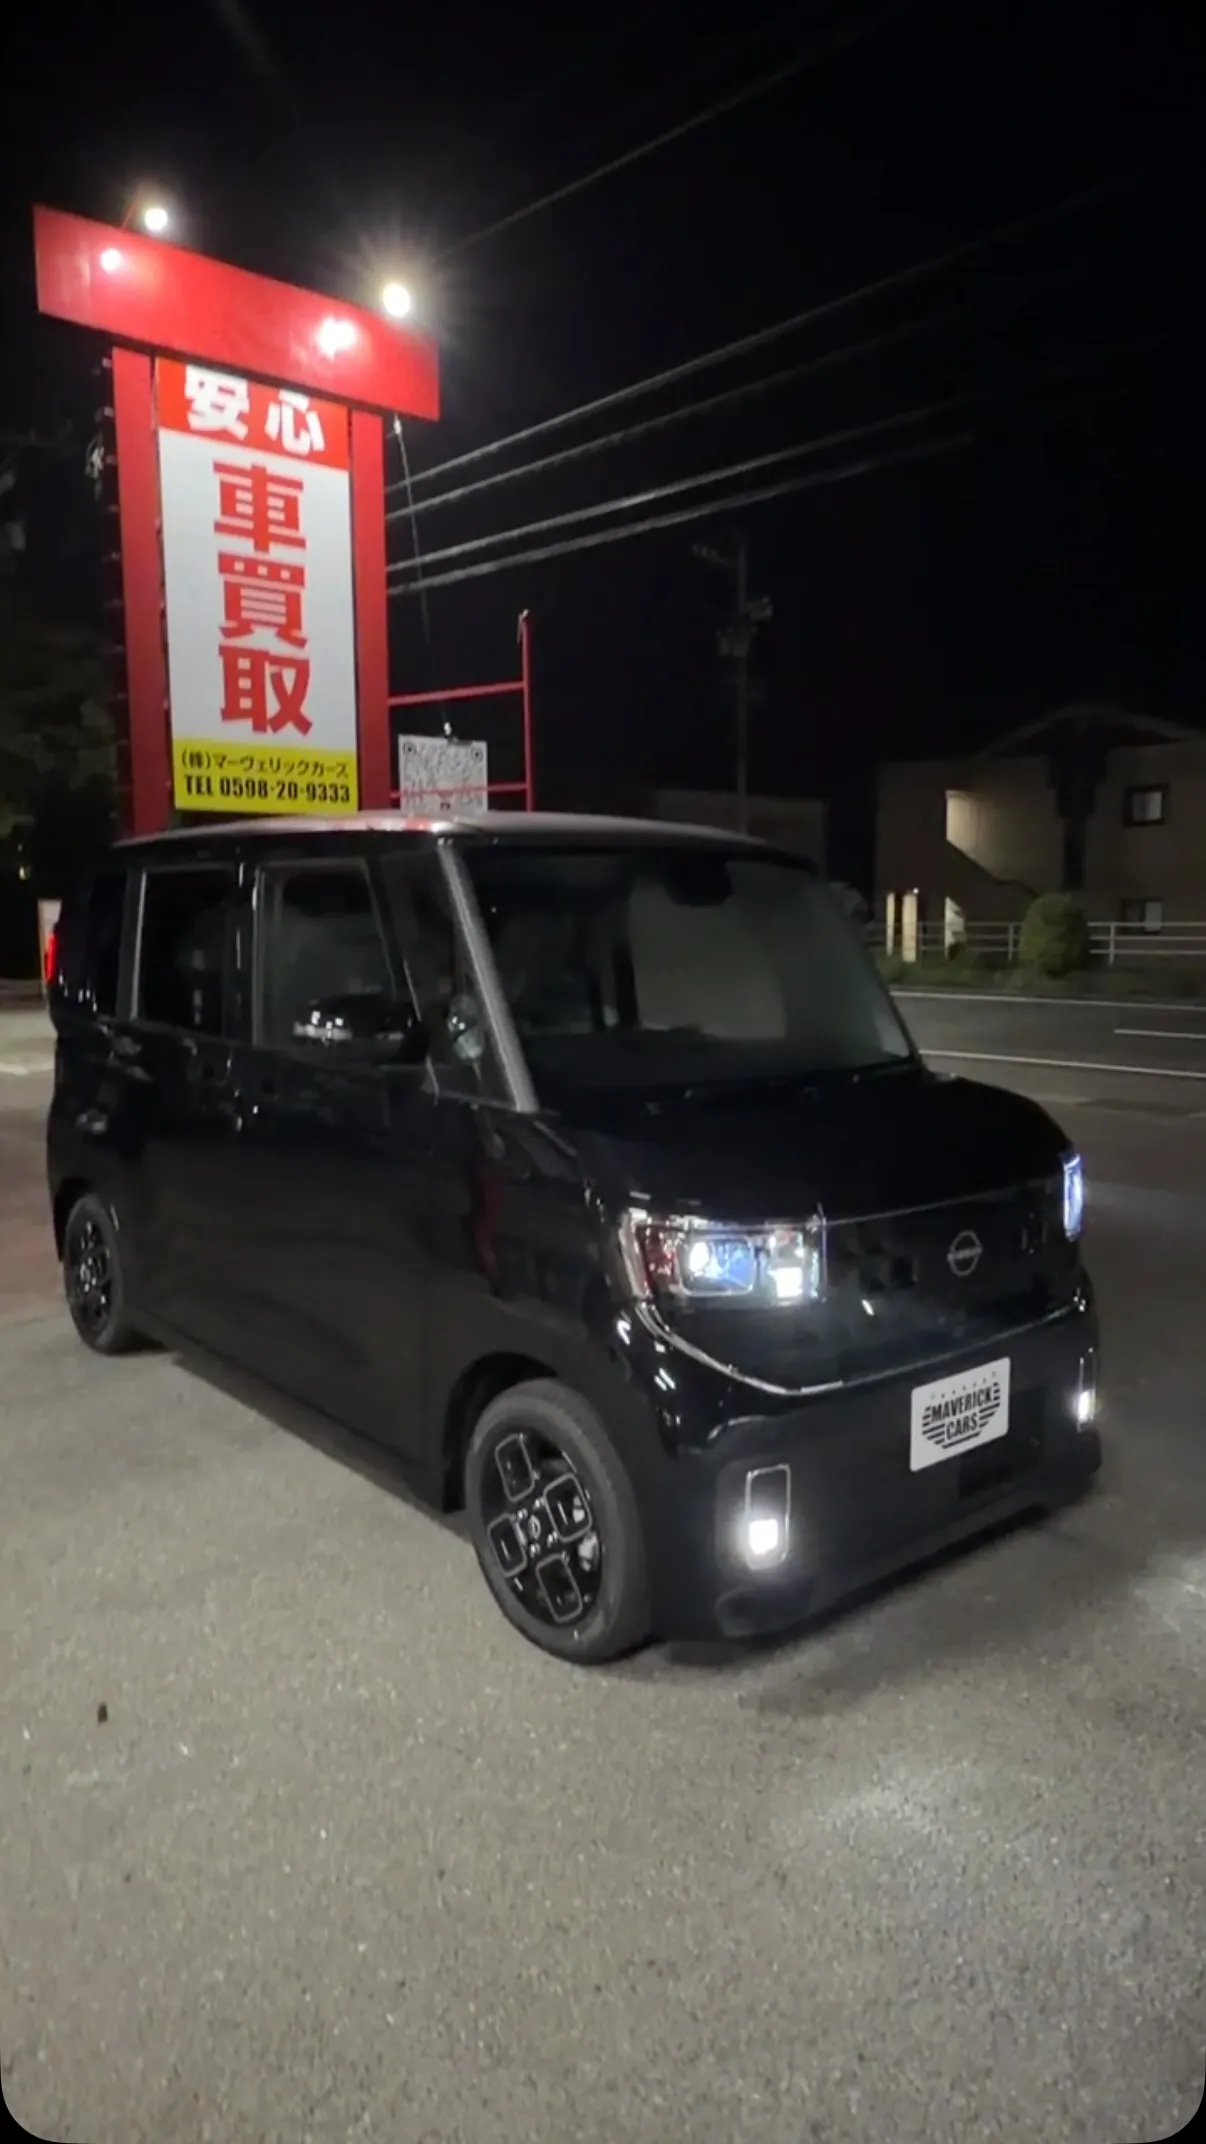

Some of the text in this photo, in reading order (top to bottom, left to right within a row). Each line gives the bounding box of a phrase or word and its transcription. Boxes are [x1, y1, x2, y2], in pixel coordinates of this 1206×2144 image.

[183, 366, 326, 456] 安心
[212, 461, 314, 737] 車買取
[184, 775, 213, 797] TEL
[930, 1385, 993, 1423] MAVERICK
[946, 1412, 978, 1440] CARS
